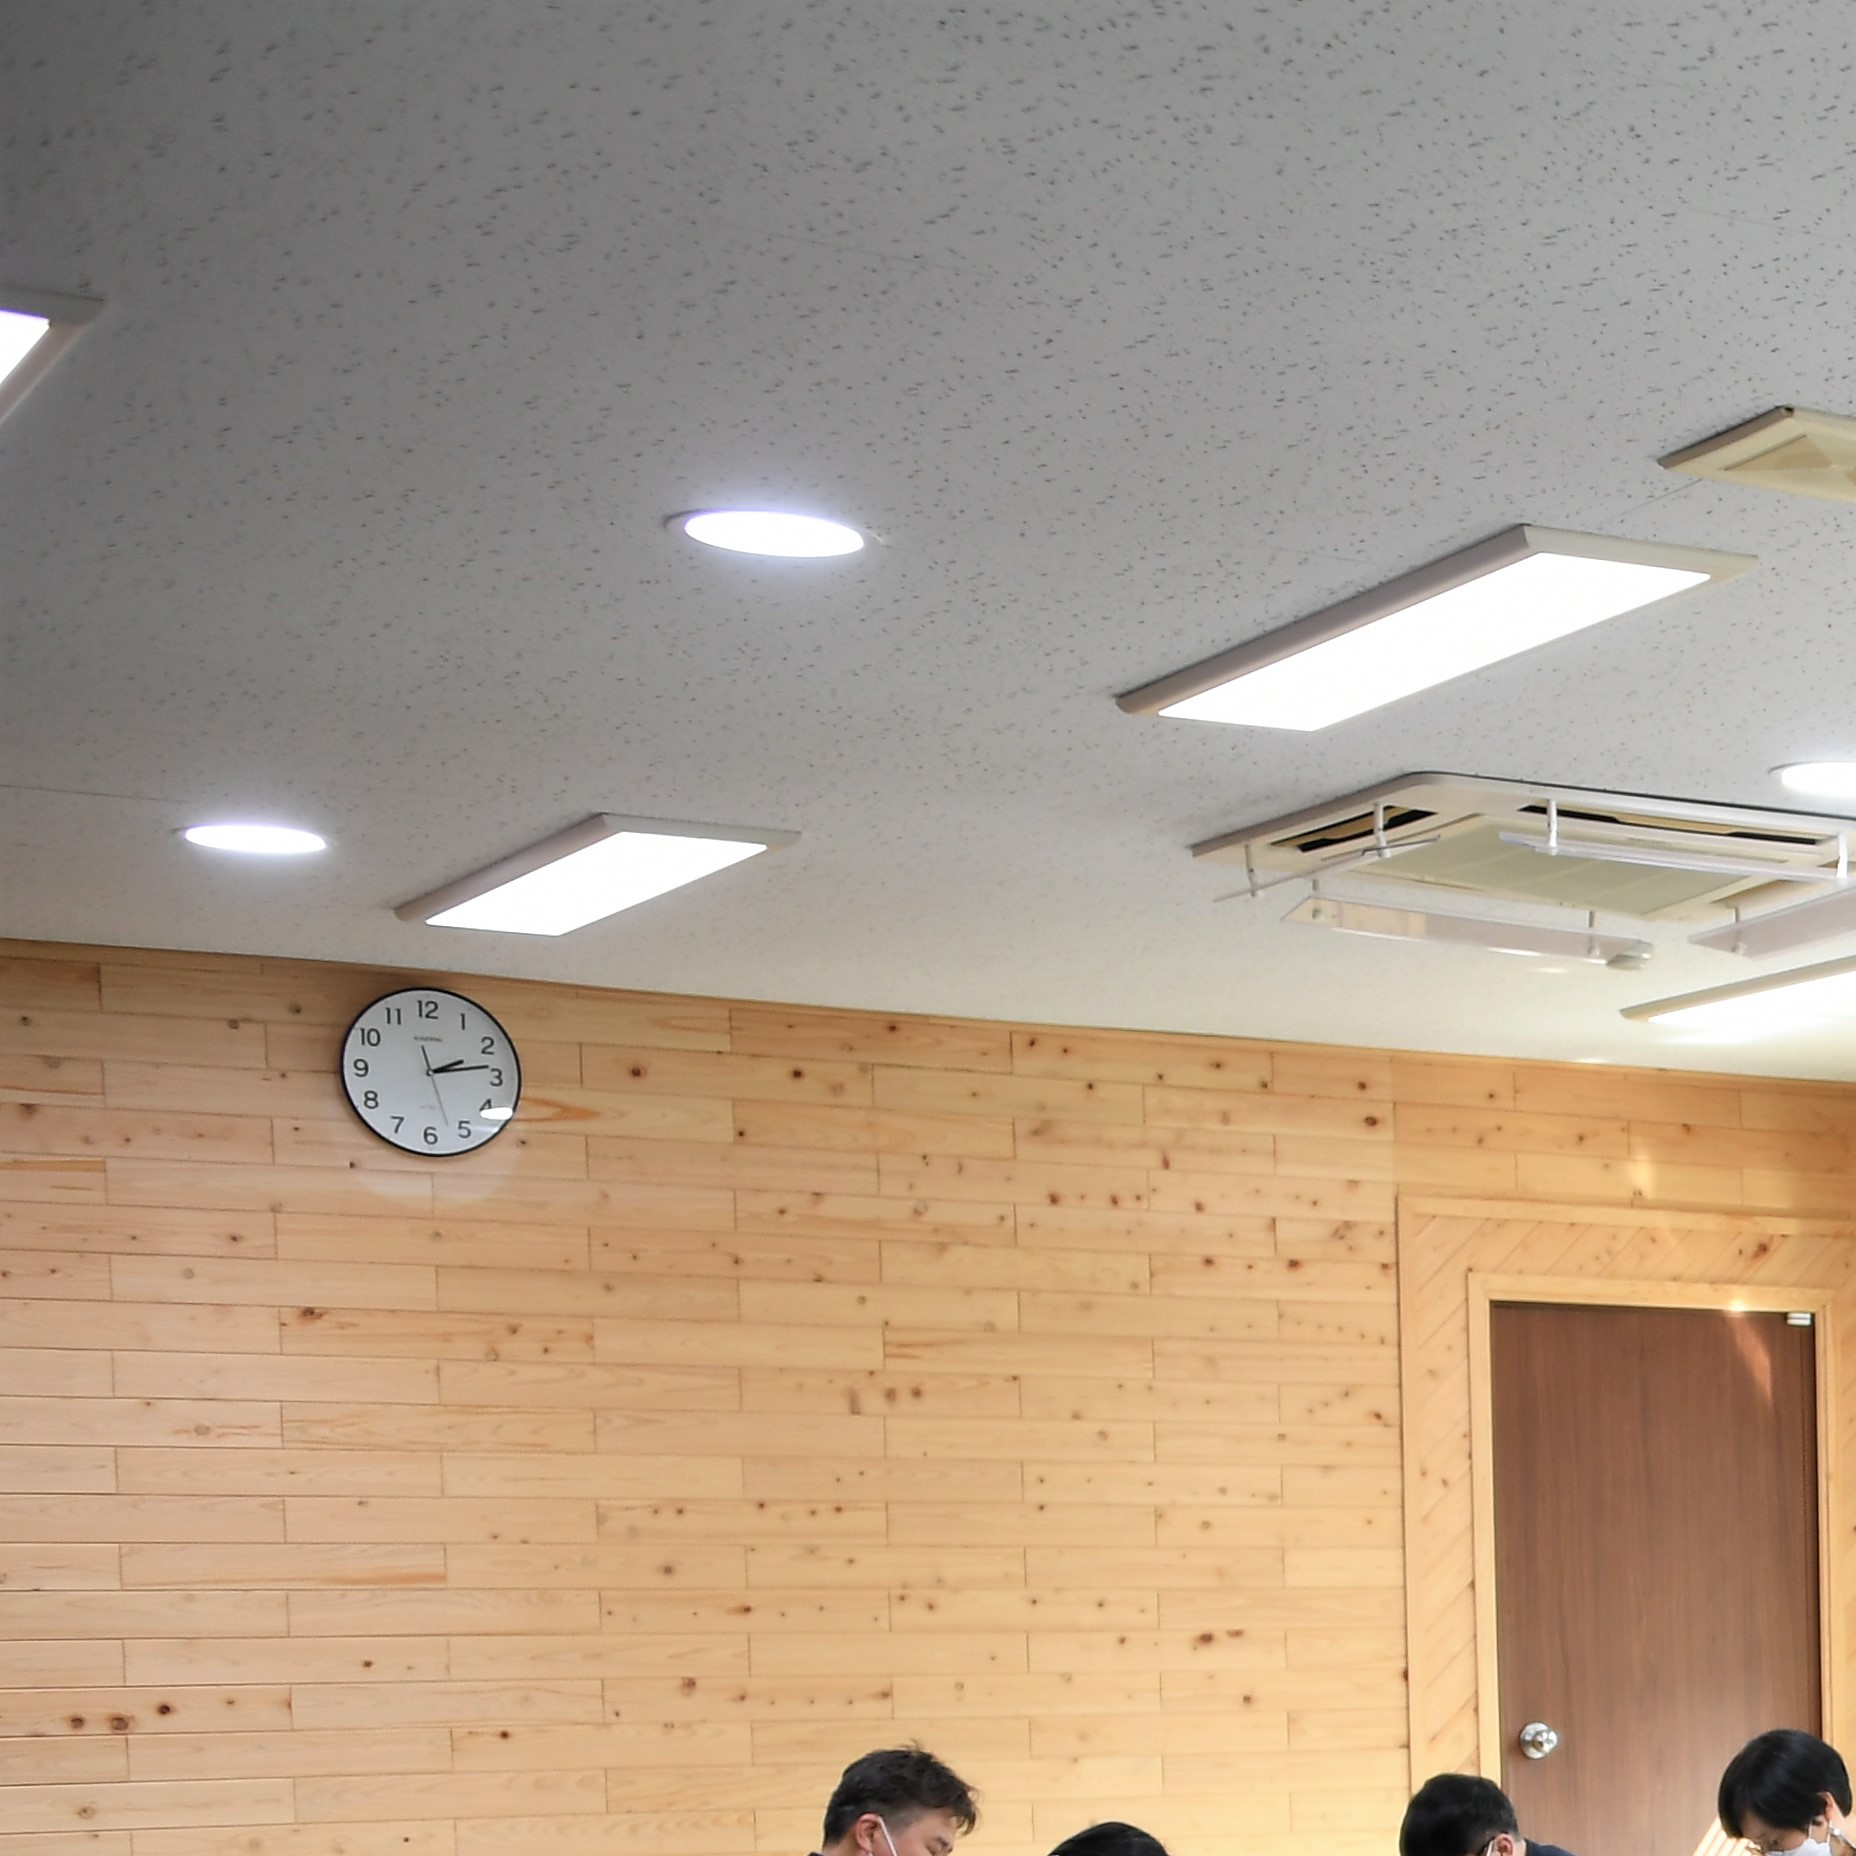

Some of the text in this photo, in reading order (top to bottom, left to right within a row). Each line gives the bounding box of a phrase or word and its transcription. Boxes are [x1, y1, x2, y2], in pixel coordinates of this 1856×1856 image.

[385, 1007, 402, 1025] 11
[417, 1000, 439, 1019] 12
[459, 1013, 466, 1030] 1
[360, 1028, 381, 1047] 10
[481, 1036, 495, 1055] 2
[353, 1058, 369, 1077] 9
[489, 1068, 503, 1086] 3
[363, 1090, 379, 1109] 8
[390, 1116, 405, 1134] 7
[457, 1121, 472, 1139] 5
[423, 1126, 438, 1145] 6
